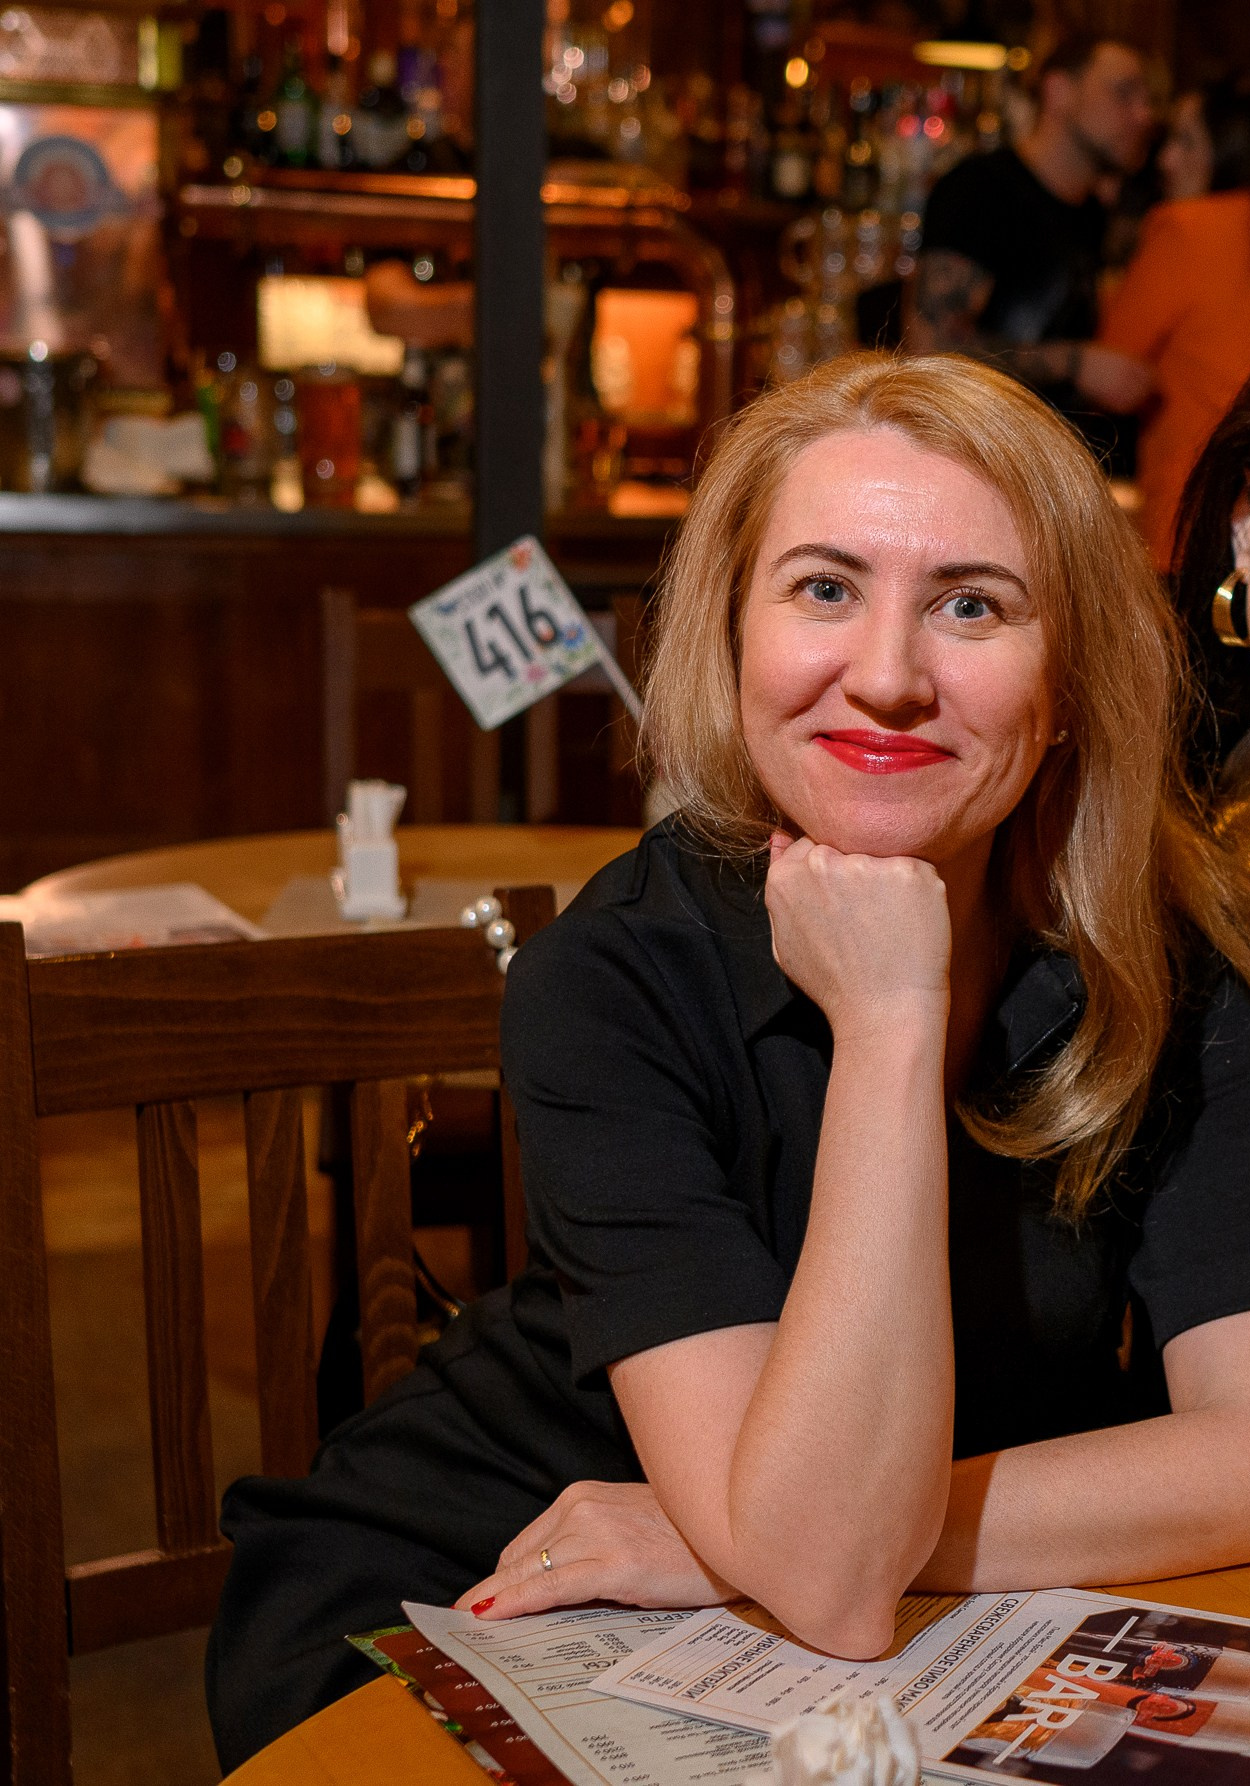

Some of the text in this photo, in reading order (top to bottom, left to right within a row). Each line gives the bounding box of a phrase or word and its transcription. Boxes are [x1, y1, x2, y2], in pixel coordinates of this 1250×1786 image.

[464, 585, 560, 681] 416
[636, 1612, 693, 1623] СЕРТЫ
[936, 1598, 1021, 1666] СВЕЖЕСВАРЕННОЕ
[680, 1659, 744, 1699] КОКТЕЙЛИ
[911, 1665, 948, 1689] ПИВО
[1003, 1653, 1128, 1729] BAR
